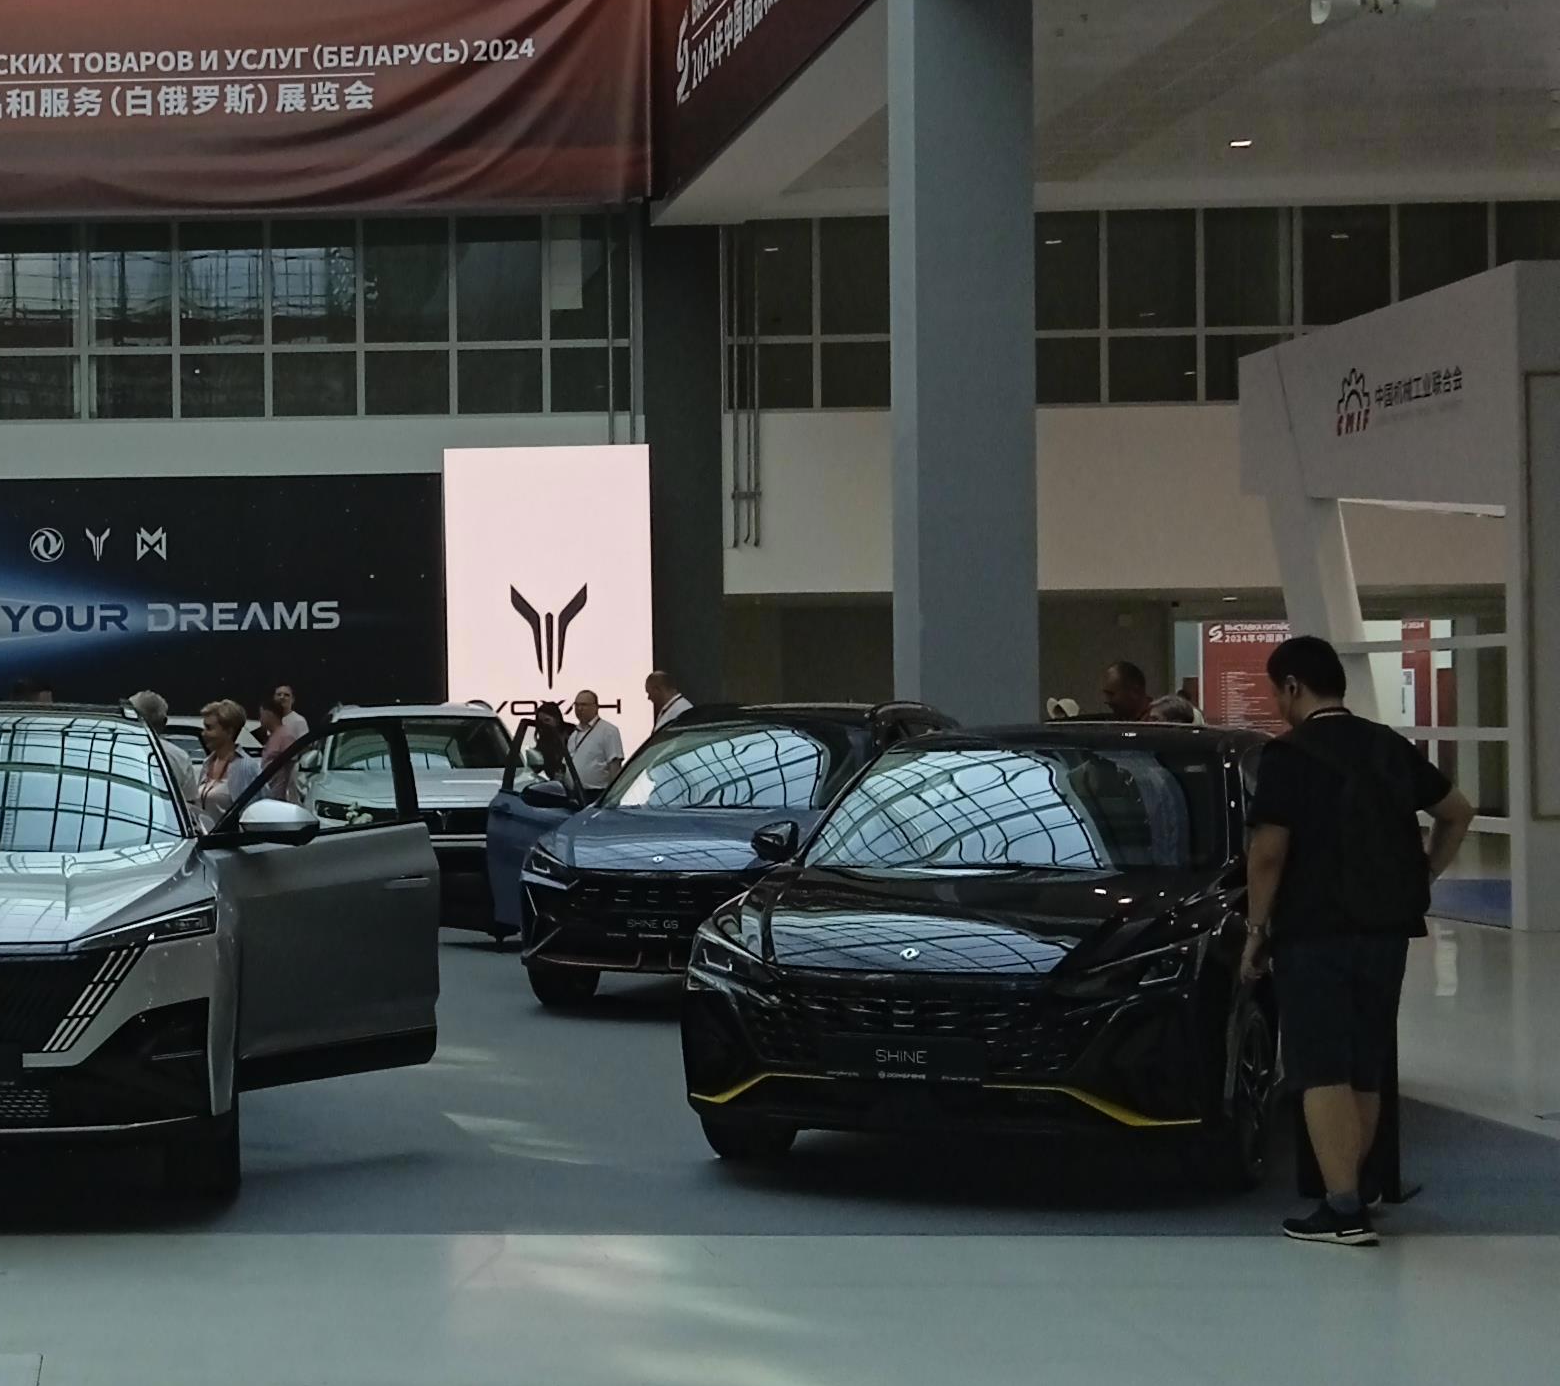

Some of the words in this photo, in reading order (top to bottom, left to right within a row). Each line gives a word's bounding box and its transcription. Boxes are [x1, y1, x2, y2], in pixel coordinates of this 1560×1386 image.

[69, 50, 194, 74] ТОВАРОВ
[200, 49, 219, 71] И
[224, 47, 309, 71] УСЛУГ
[312, 40, 469, 71] (БЕЛАРУСЬ)
[473, 37, 536, 62] 2024
[0, 603, 131, 633] YOUR
[146, 600, 341, 631] DREAMS
[875, 1048, 928, 1065] SHINE
